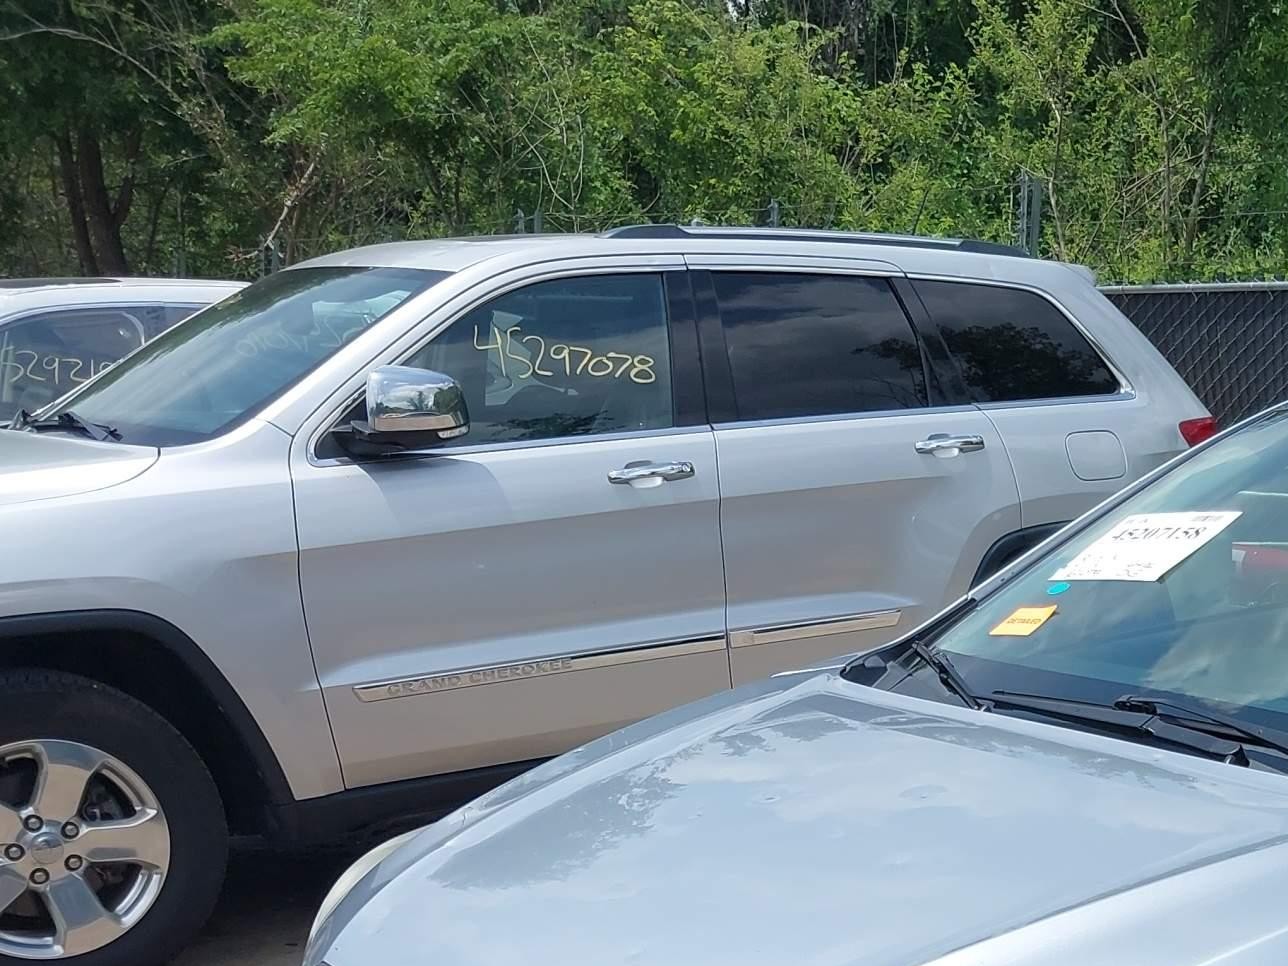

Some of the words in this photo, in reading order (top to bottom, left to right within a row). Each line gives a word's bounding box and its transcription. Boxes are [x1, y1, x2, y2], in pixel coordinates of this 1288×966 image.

[473, 324, 656, 384] 45297078
[1111, 527, 1207, 541] 45207158
[386, 675, 464, 697] GRAND
[469, 657, 573, 684] CHEROKEE
